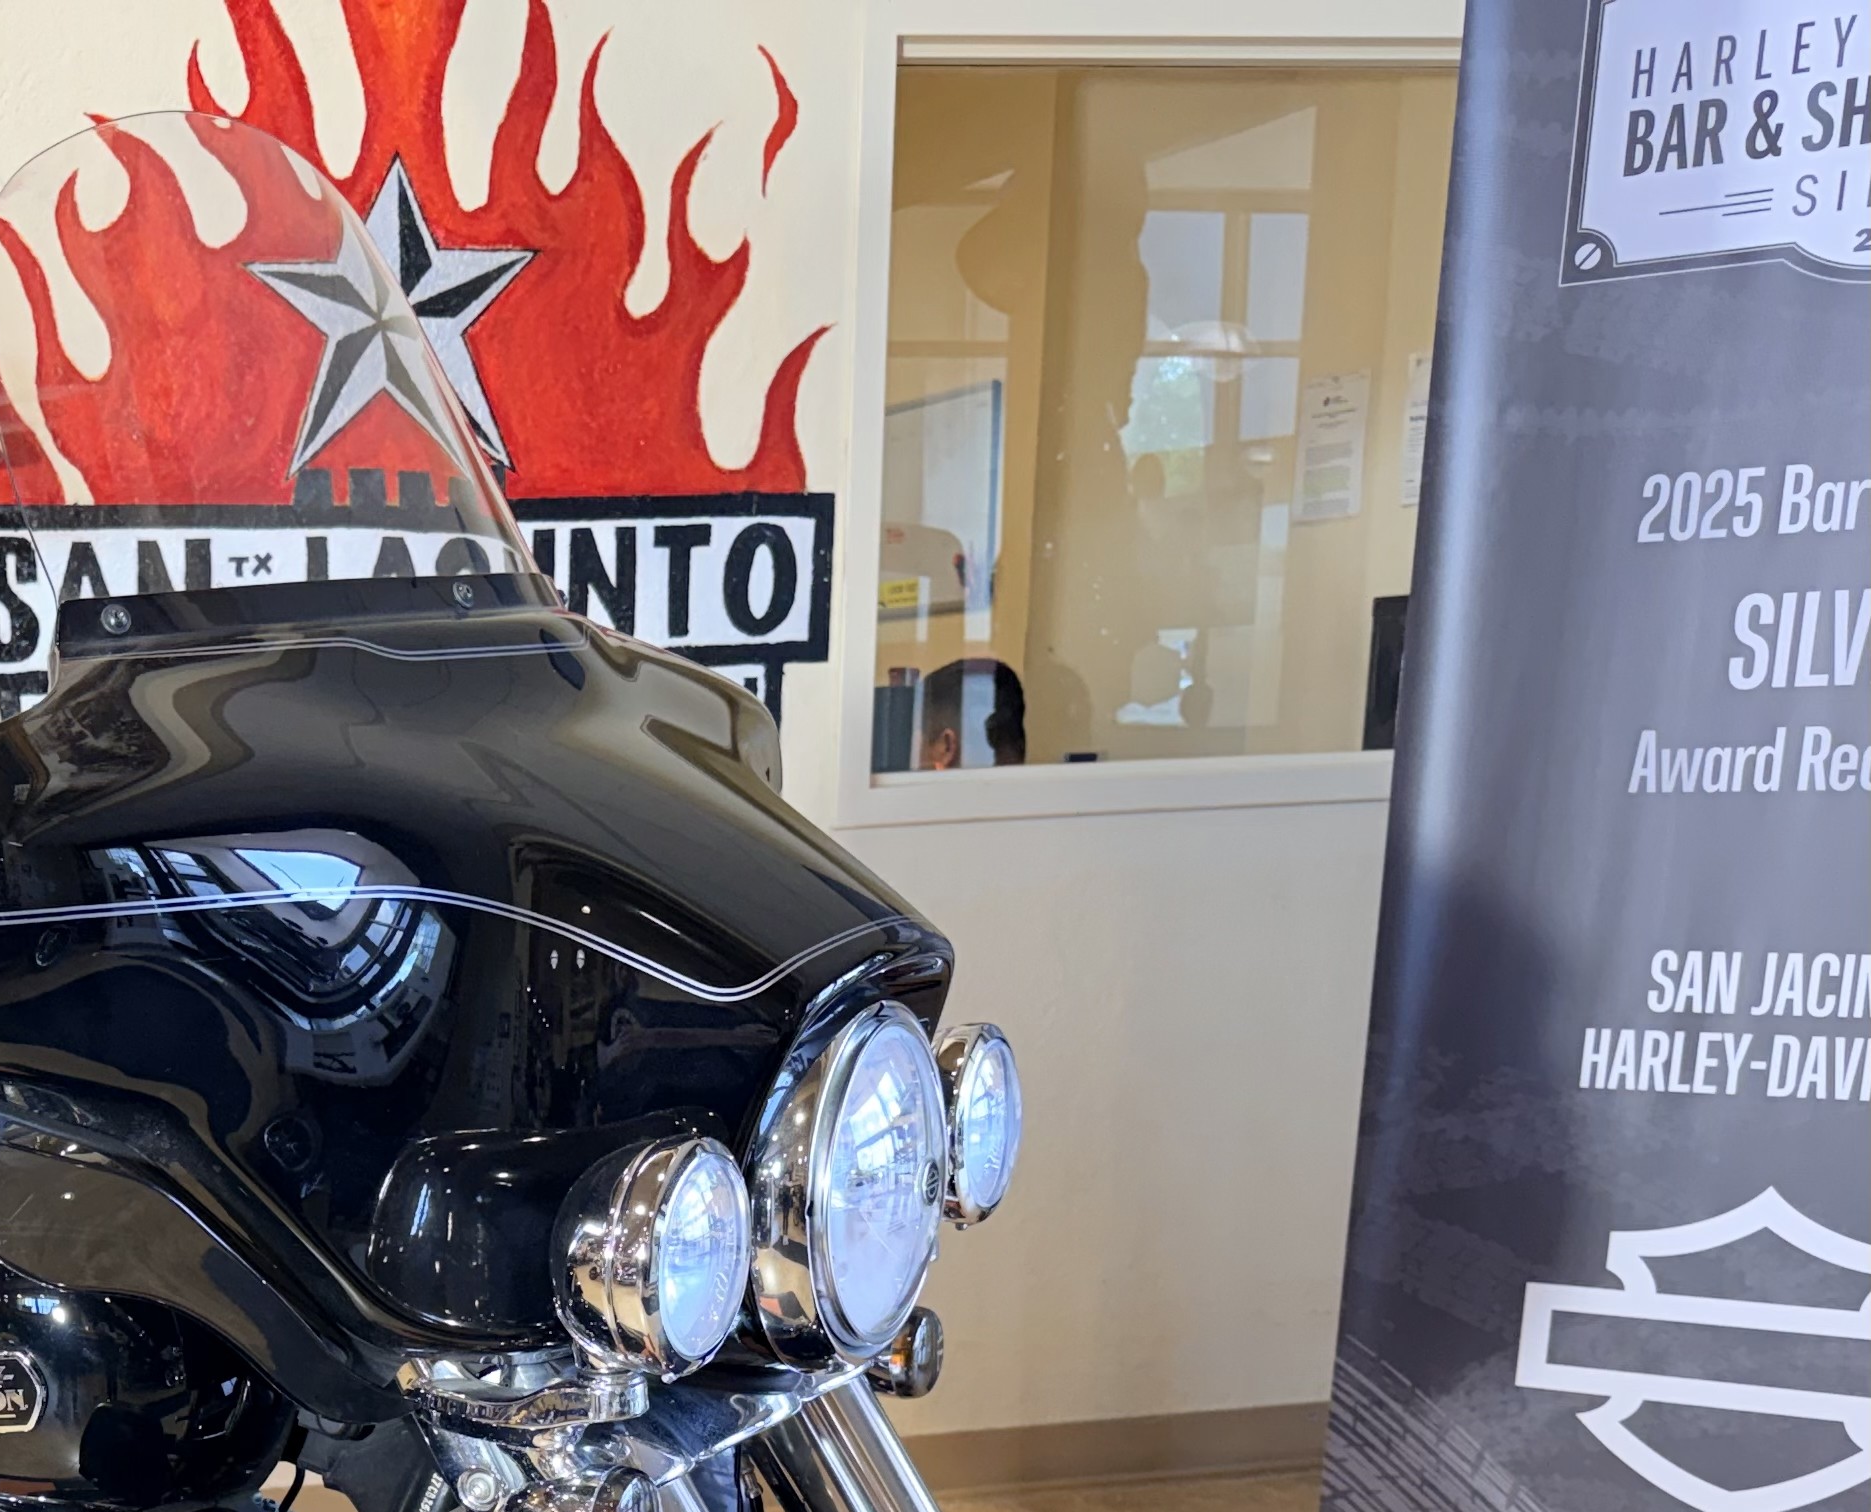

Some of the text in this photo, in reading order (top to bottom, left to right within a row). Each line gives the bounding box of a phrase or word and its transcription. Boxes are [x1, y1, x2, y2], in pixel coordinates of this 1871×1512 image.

[1631, 14, 1858, 99] HARLEY
[1623, 74, 1871, 178] BAR & SH
[1792, 169, 1871, 217] SI
[1637, 463, 1871, 543] 2025 Bar
[228, 552, 274, 577] TX
[1728, 587, 1871, 691] SILV
[1628, 726, 1787, 794] Award
[1646, 949, 1743, 1015] SAN
[1578, 1027, 1871, 1102] HARLEY-DAVI
